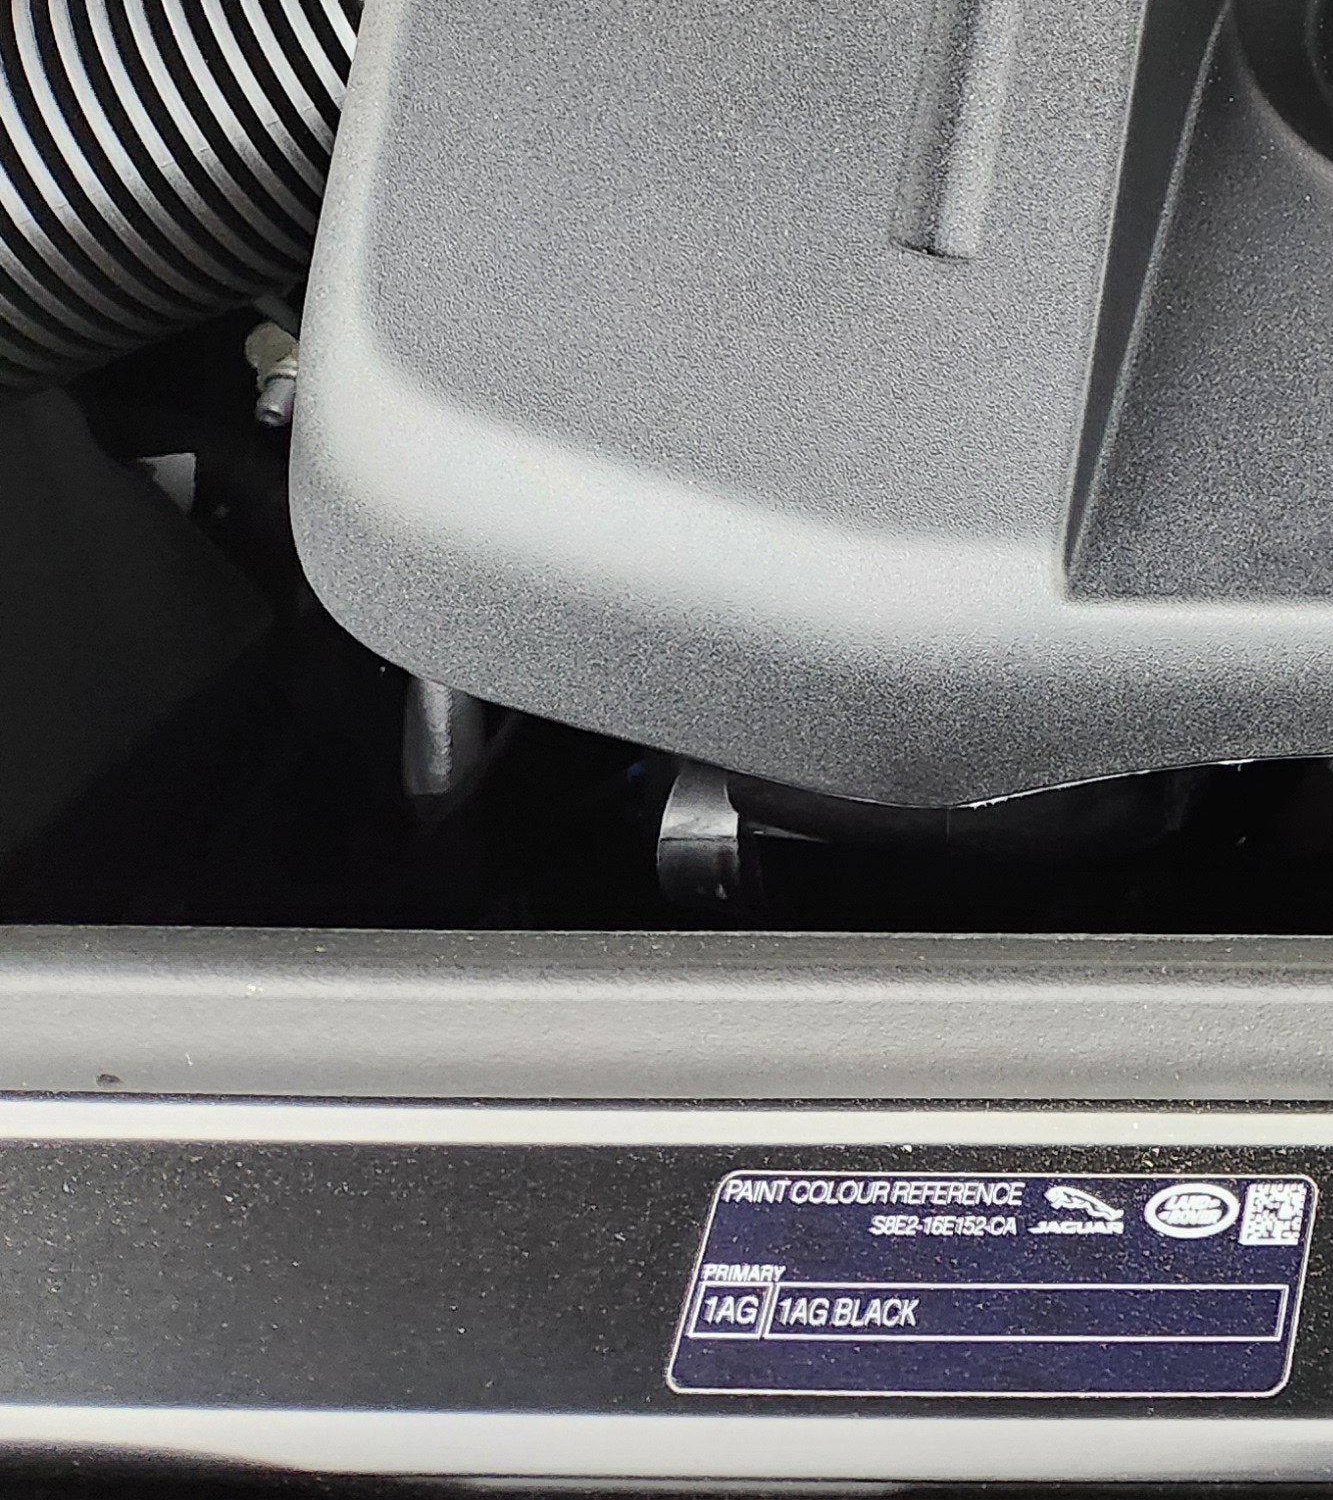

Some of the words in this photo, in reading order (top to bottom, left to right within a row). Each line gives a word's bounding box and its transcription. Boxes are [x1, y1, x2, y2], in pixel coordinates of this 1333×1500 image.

[724, 1178, 790, 1203] PAINT
[791, 1179, 893, 1205] COLOUR
[892, 1181, 1025, 1206] REFERENCE
[1027, 1221, 1124, 1235] JAGUAR
[703, 1263, 786, 1282] PRIMARY
[704, 1295, 759, 1325] 1AG
[778, 1297, 830, 1327] 1AG
[832, 1297, 920, 1328] BLACK
